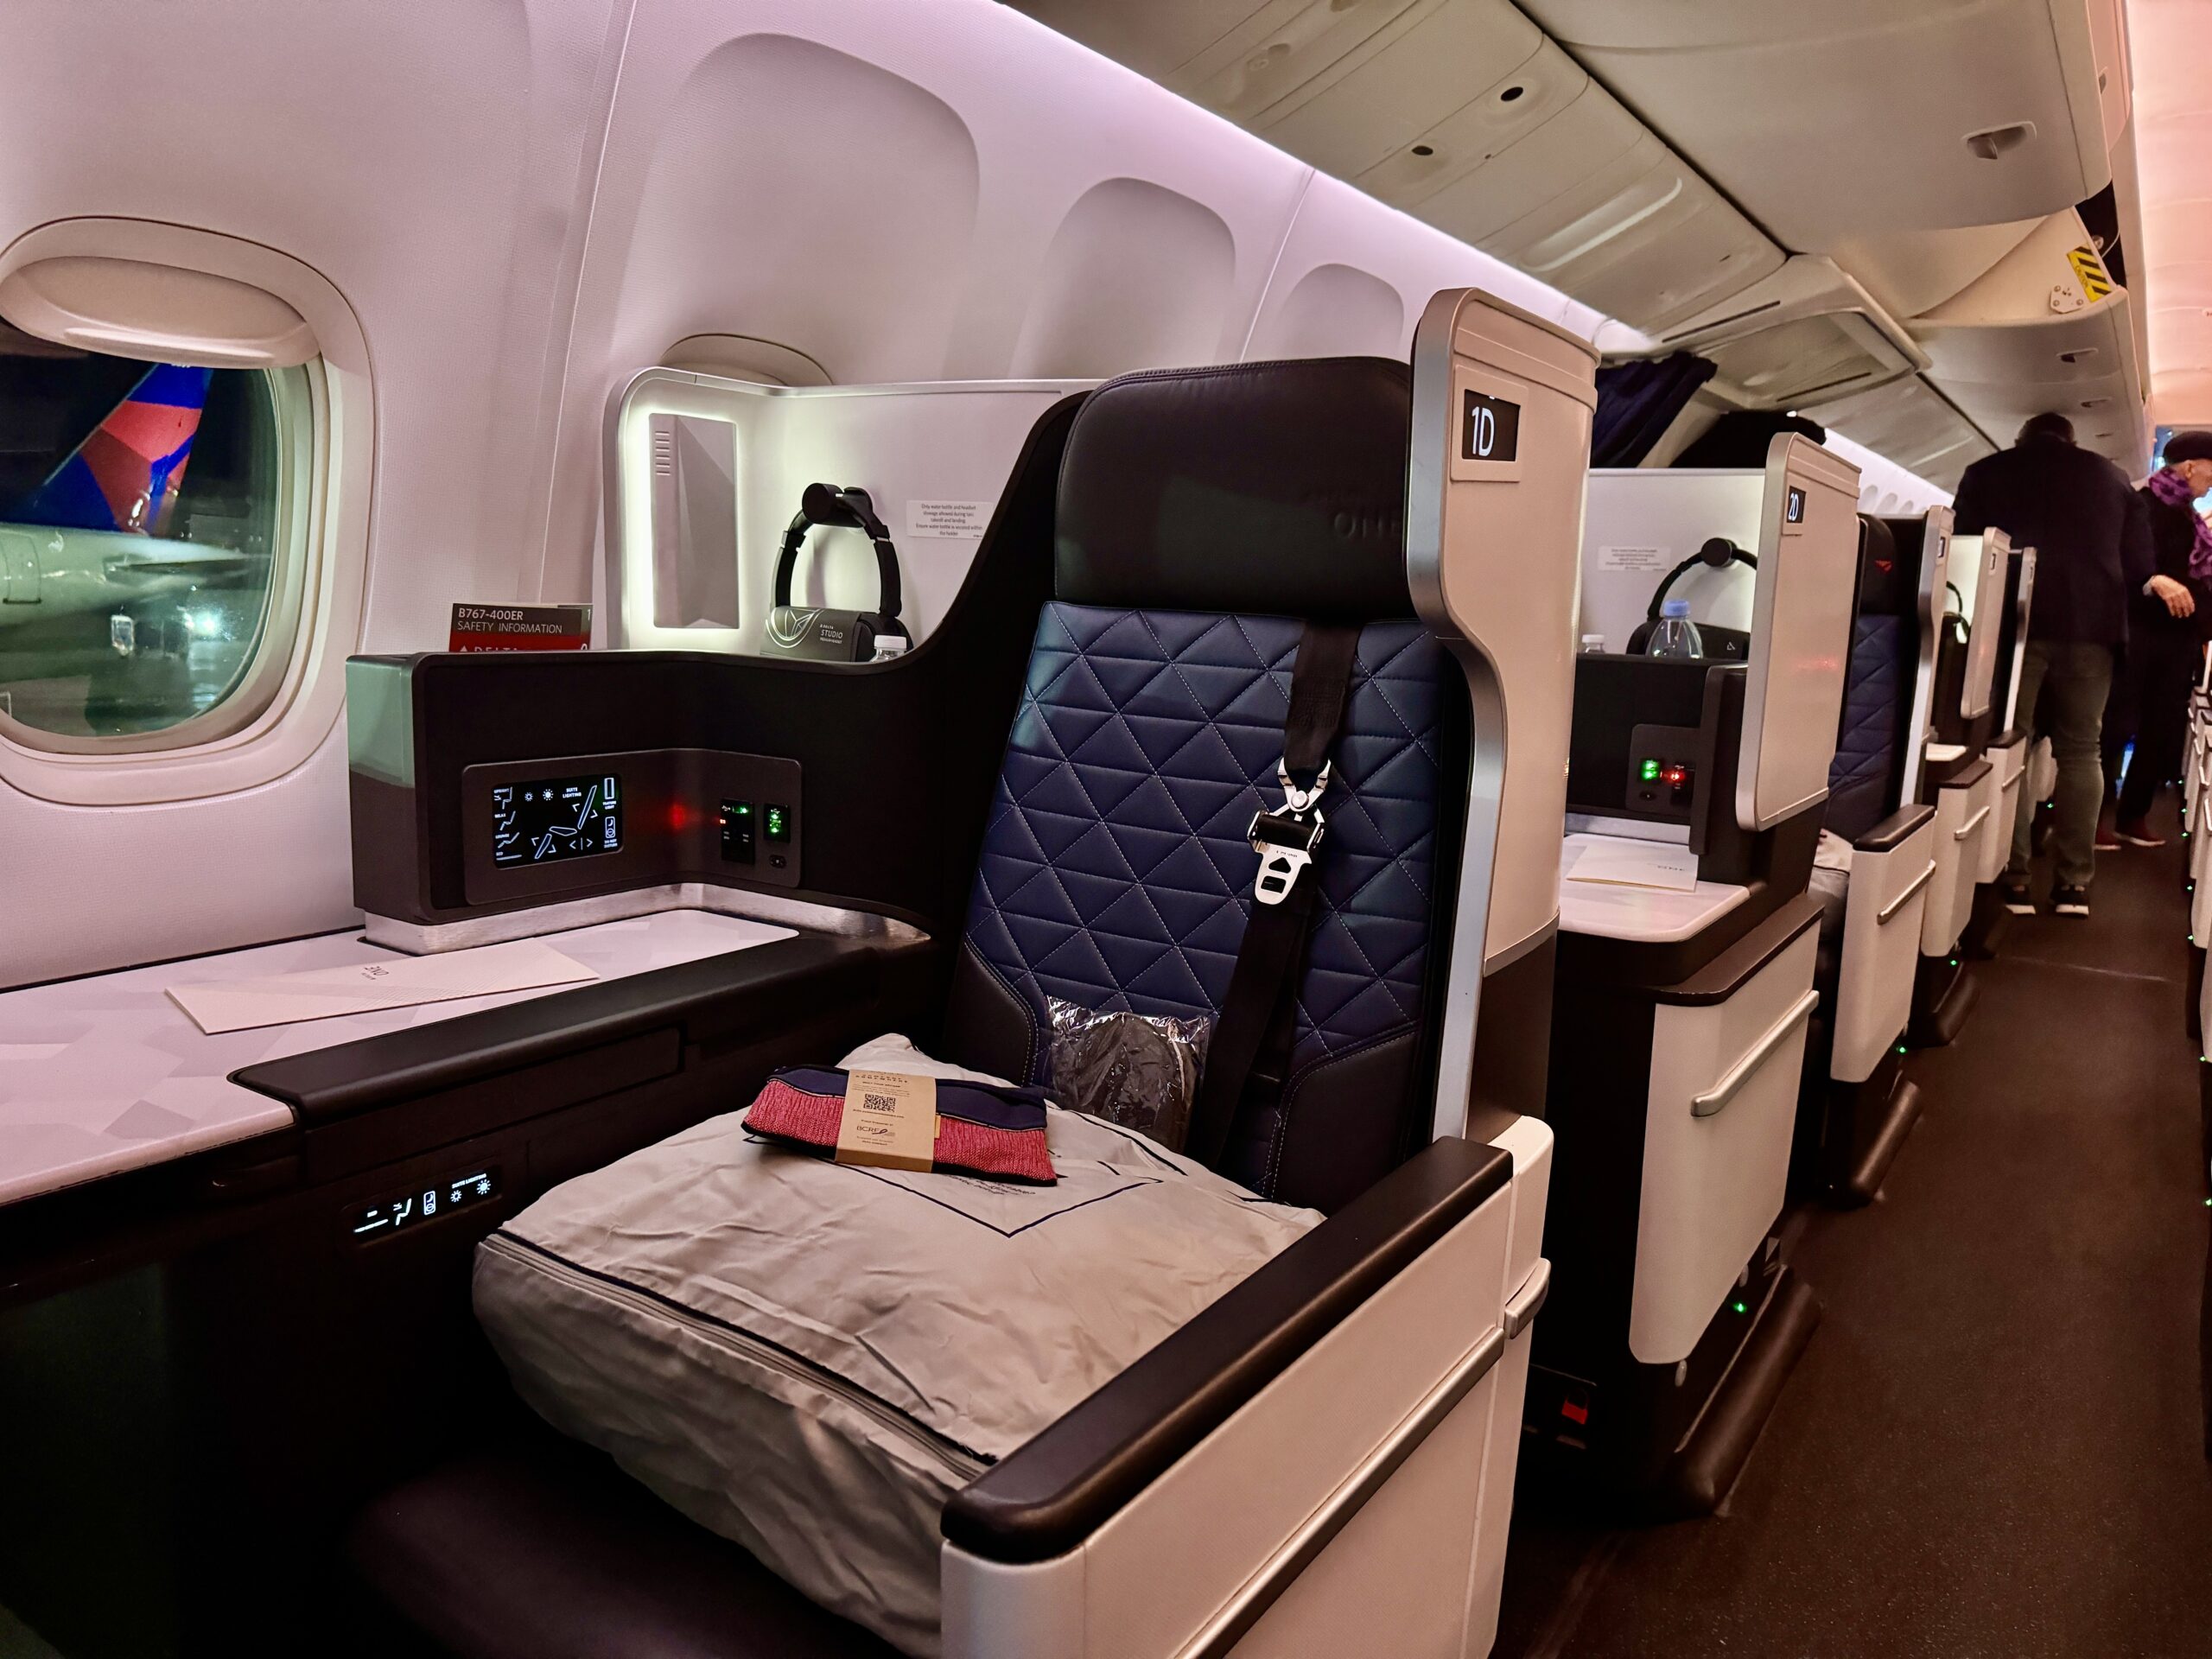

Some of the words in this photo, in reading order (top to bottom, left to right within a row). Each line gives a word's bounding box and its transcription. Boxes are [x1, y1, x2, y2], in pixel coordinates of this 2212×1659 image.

[1471, 406, 1494, 456] 1D
[1789, 493, 1799, 521] 2D
[458, 607, 524, 620] B767-400ER
[457, 620, 494, 632] SAFETY
[499, 622, 563, 633] INFORMATION
[821, 629, 843, 639] STUDIO
